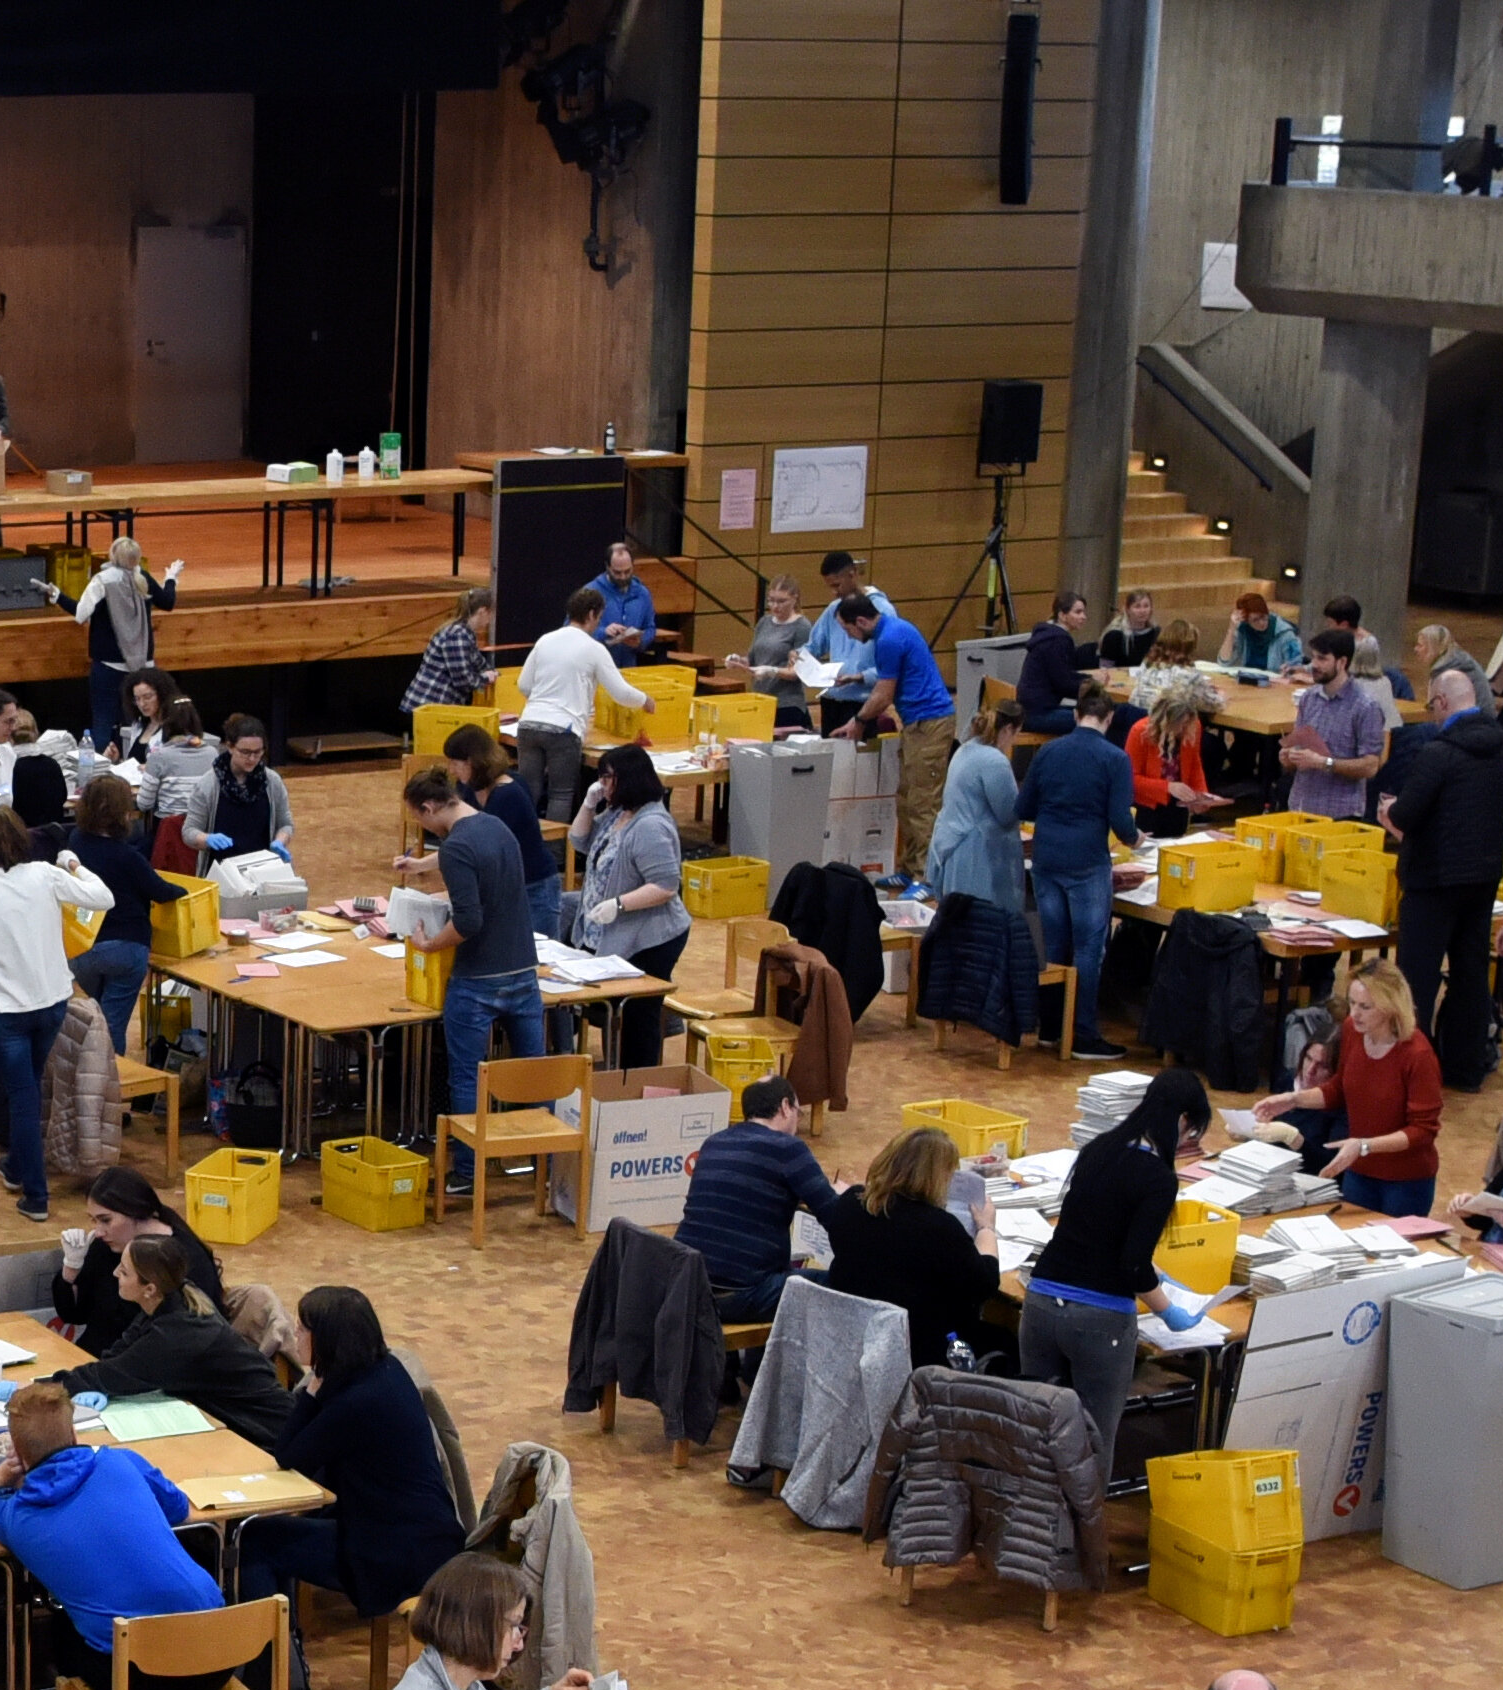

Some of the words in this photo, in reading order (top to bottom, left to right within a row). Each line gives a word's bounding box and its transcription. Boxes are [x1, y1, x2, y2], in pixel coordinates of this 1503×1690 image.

[612, 1129, 648, 1145] öffnen!
[610, 1155, 683, 1179] POWERS
[1345, 1390, 1383, 1485] POWERS
[1256, 1481, 1279, 1494] 6332
